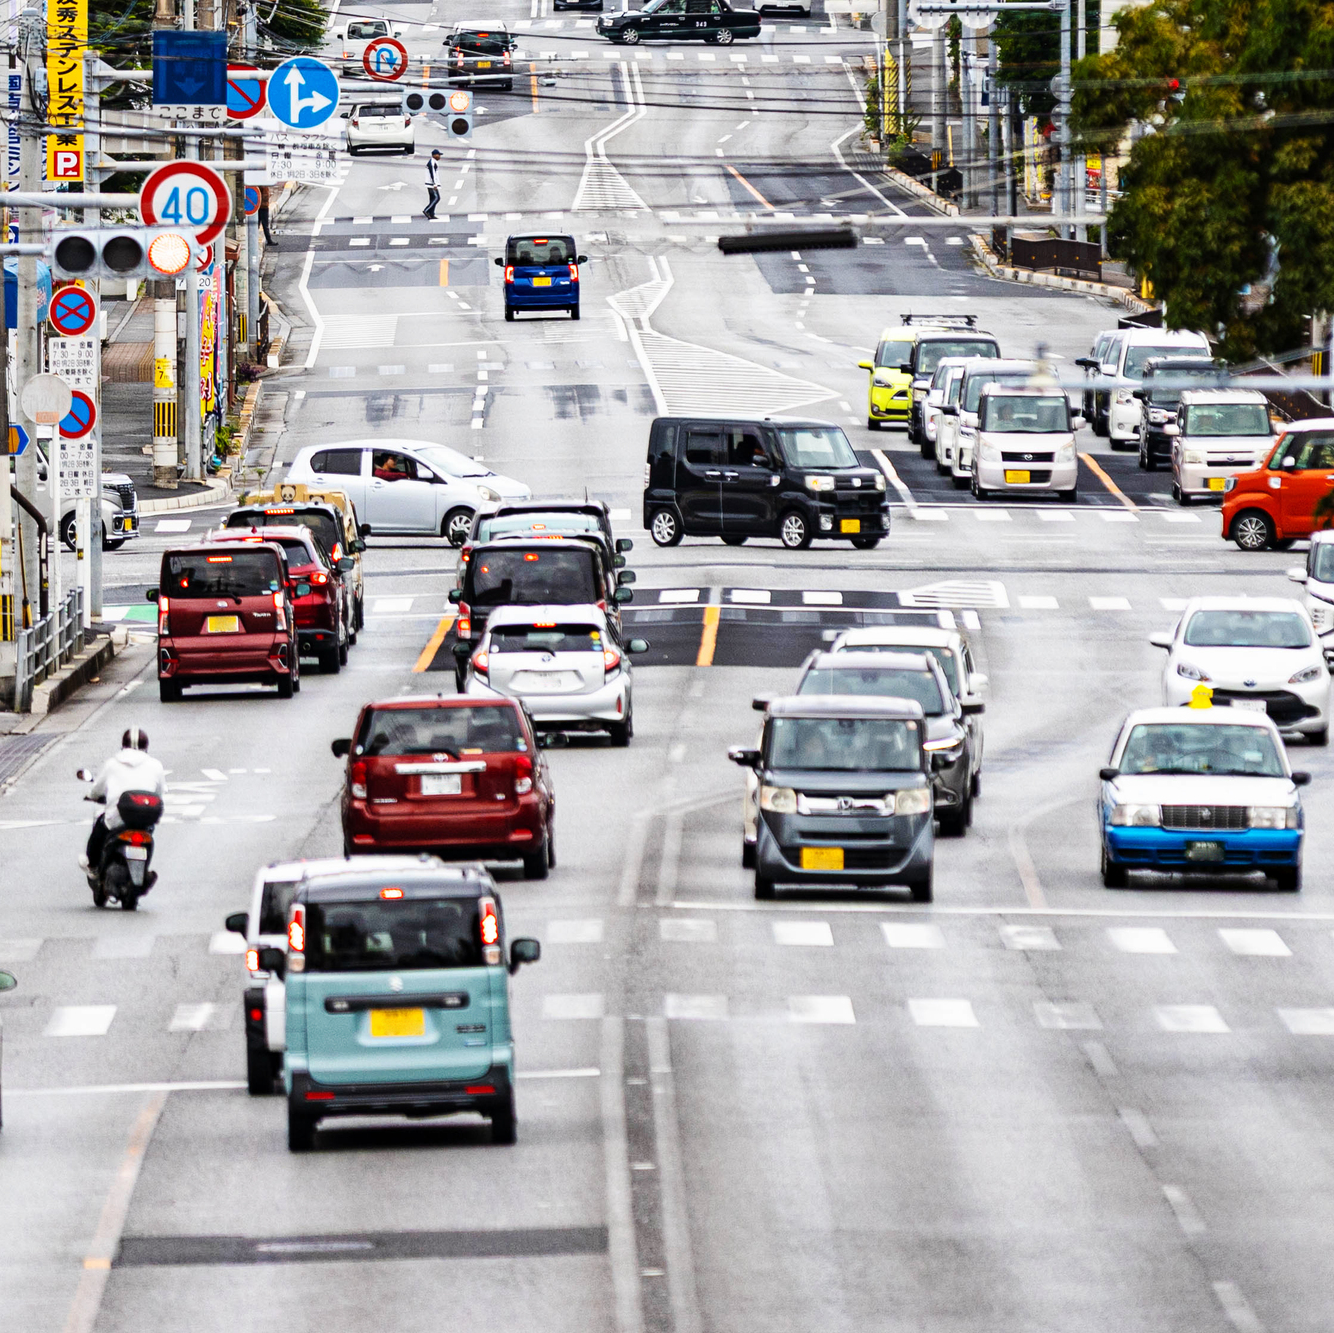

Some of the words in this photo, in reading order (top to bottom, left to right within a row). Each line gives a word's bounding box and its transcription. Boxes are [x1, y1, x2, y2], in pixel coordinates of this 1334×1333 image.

[159, 106, 222, 119] ここまで
[57, 152, 78, 176] P
[161, 186, 209, 225] 40
[199, 278, 211, 286] 20
[65, 377, 91, 385] こまで
[64, 488, 92, 496] こまで
